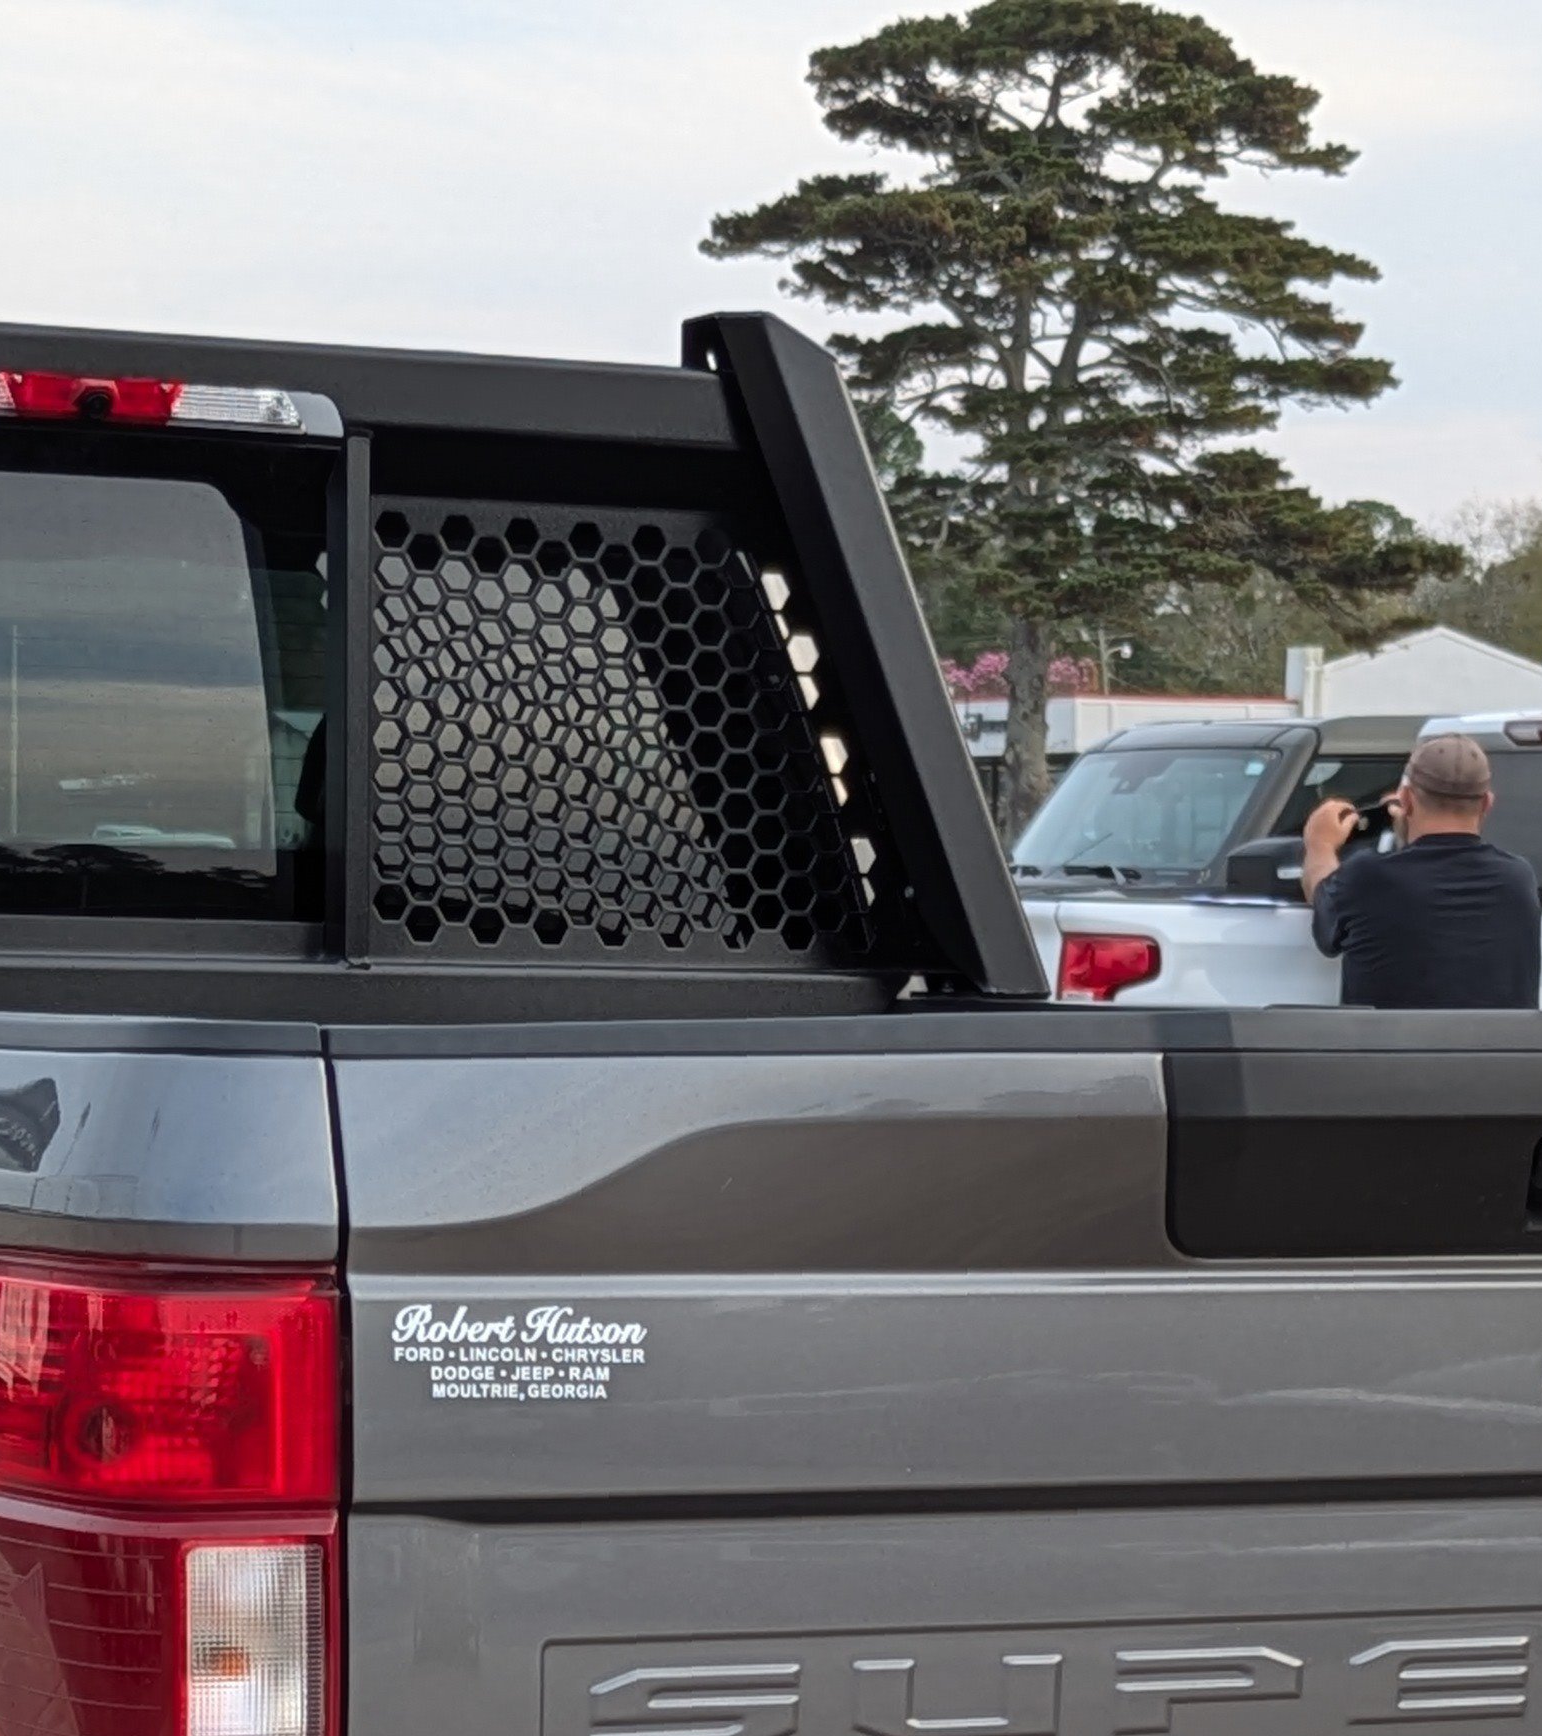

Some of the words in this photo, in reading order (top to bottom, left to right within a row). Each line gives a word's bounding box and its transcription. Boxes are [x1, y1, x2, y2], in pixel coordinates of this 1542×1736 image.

[391, 1303, 517, 1344] Robert
[519, 1304, 648, 1345] Hutson
[394, 1347, 445, 1363] FORD
[459, 1347, 538, 1363] LINCOLN
[551, 1348, 646, 1364] CHRYSLER
[430, 1366, 495, 1382] DODGE
[510, 1366, 555, 1382] JEEP
[568, 1366, 611, 1382] RAM
[432, 1383, 526, 1401] MOULTRIE,
[527, 1384, 608, 1400] GEORGIA
